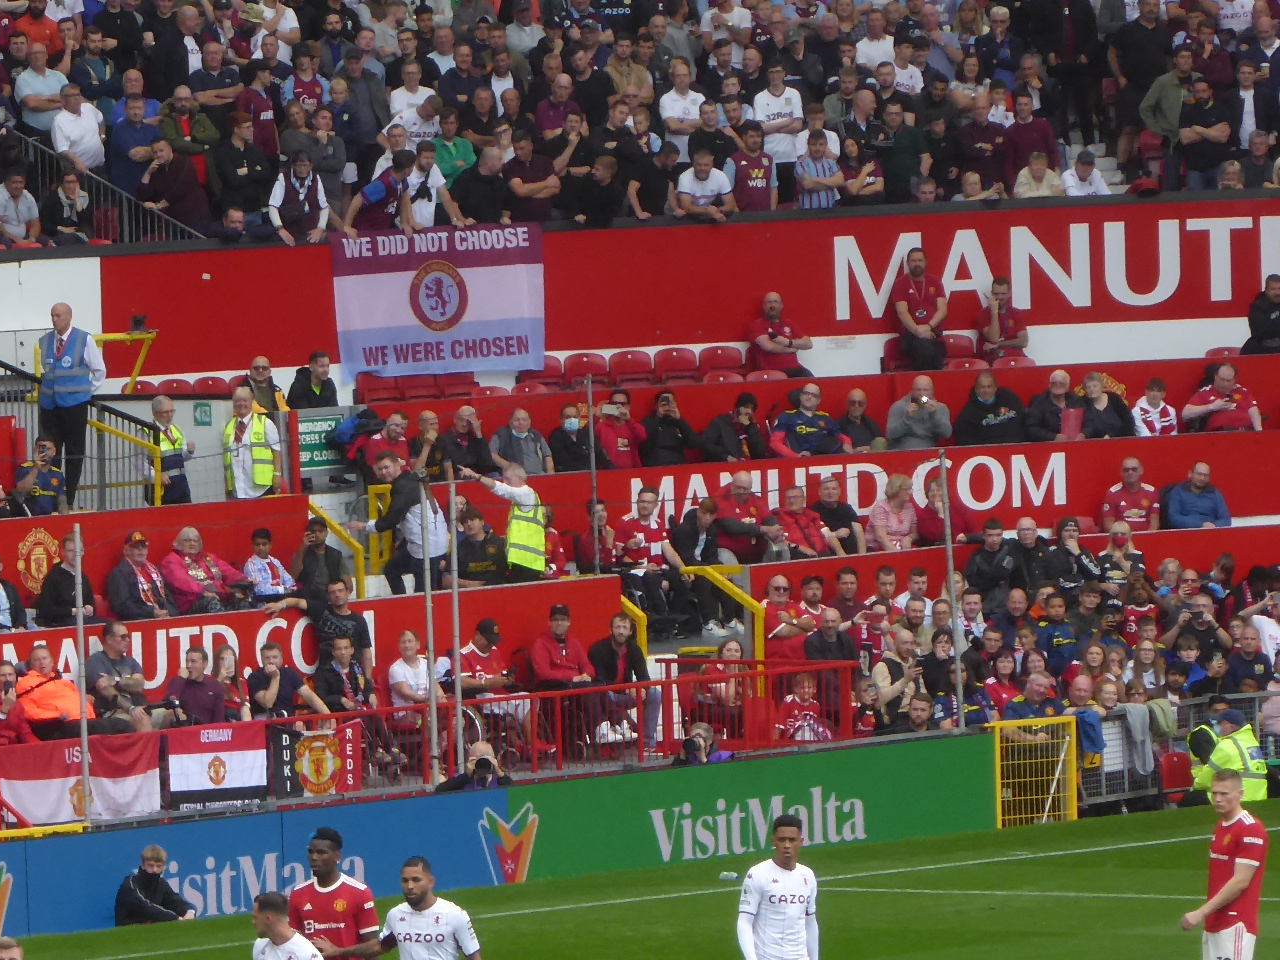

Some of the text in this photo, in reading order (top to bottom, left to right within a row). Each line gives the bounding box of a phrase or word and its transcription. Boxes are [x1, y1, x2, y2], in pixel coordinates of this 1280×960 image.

[342, 227, 529, 258] WE DID NOT CHOOSE
[362, 335, 530, 367] WE WERE CHOSEN
[298, 421, 336, 432] MERGENCY
[630, 452, 1068, 528] MAUDCOM
[3, 610, 376, 690] AUTD.CO
[200, 729, 233, 743] GERMANY
[65, 747, 92, 764] US
[648, 785, 868, 862] VisitMalta
[133, 852, 365, 920] isitMaa
[397, 932, 445, 943] CAZOO
